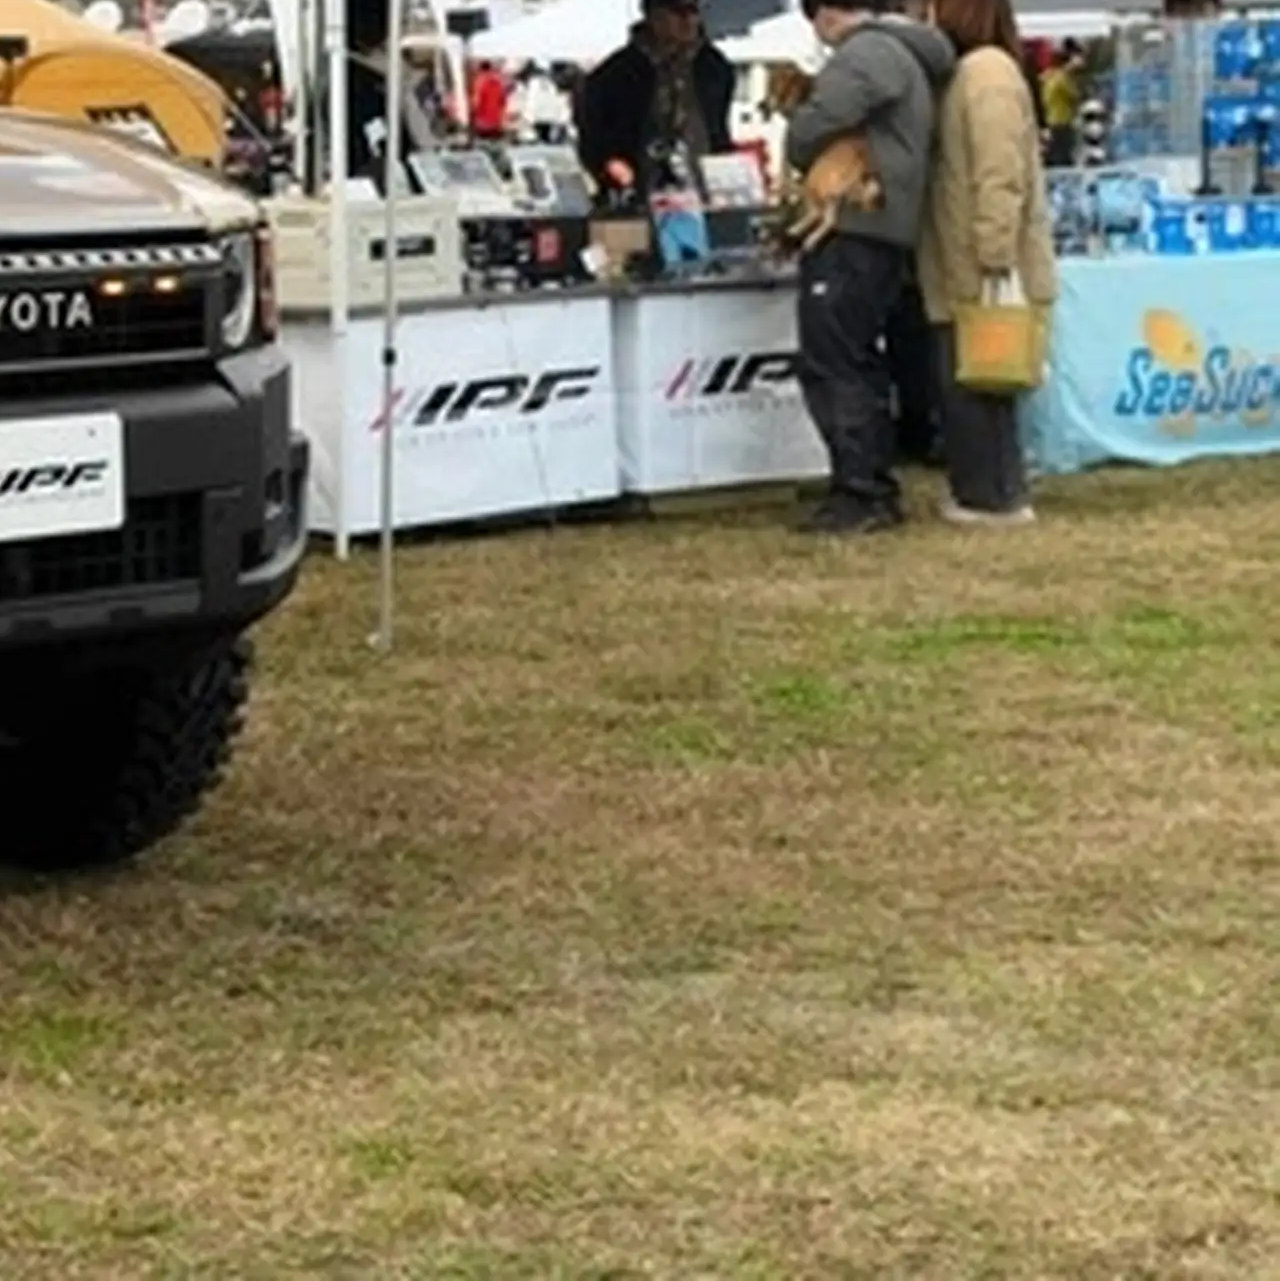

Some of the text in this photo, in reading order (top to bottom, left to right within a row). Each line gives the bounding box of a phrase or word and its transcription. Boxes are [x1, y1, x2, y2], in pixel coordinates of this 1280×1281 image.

[413, 366, 601, 427] IPF
[702, 350, 804, 395] IP
[1113, 345, 1280, 417] SeaSuc
